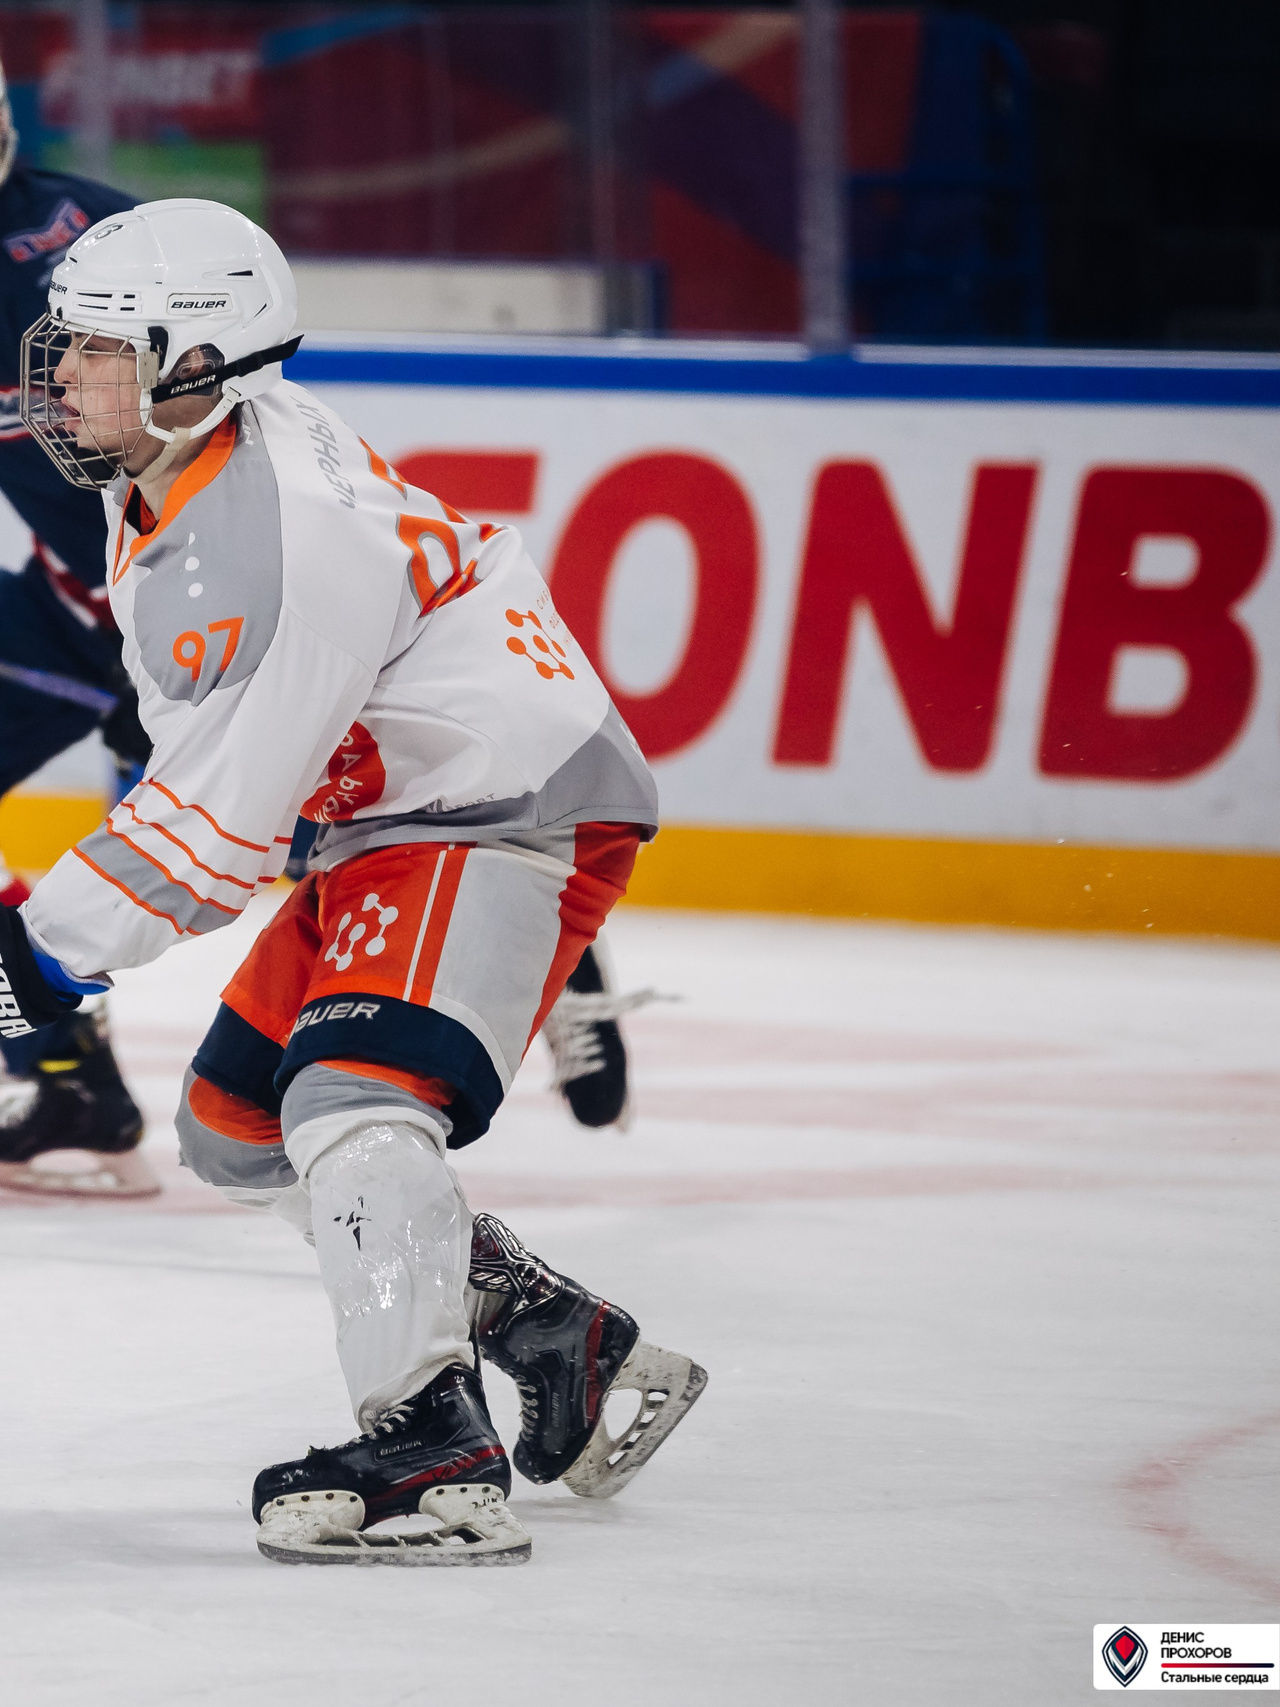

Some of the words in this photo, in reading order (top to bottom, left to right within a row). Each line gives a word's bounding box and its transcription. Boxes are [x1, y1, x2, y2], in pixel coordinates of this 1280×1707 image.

[50, 281, 68, 295] AUER
[171, 300, 227, 309] BAUER
[170, 374, 217, 395] BAUER
[172, 616, 244, 682] 97
